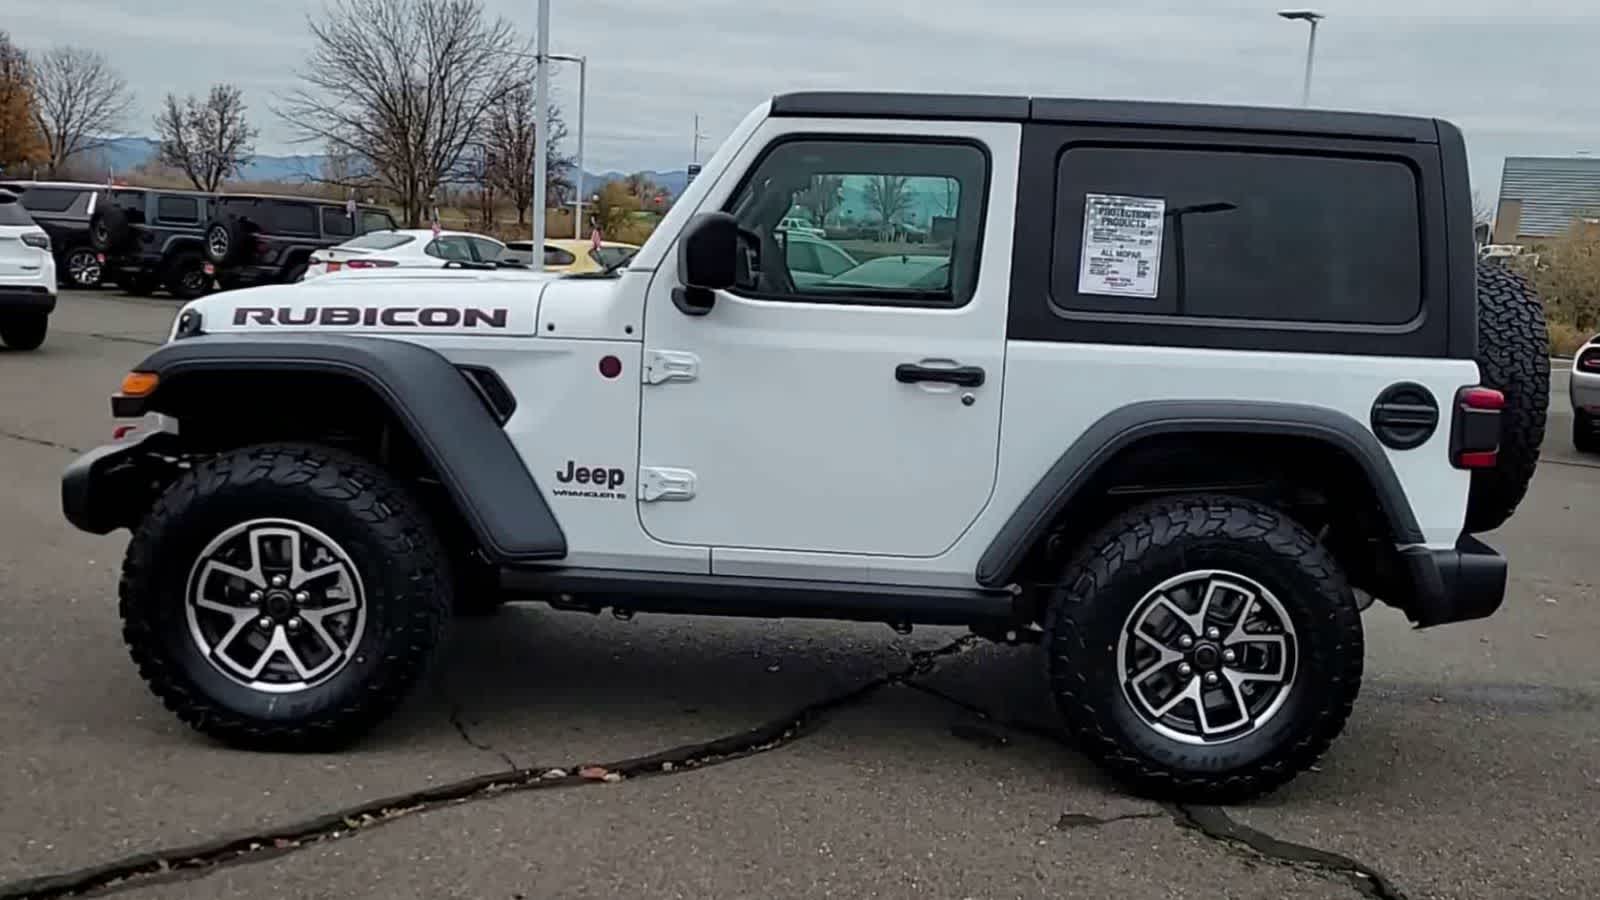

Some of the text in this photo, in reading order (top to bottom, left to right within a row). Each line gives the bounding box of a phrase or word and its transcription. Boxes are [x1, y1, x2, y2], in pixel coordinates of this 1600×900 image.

[1101, 217, 1146, 228] PRODUCTS
[1101, 249, 1142, 259] ALL MOPAR
[232, 307, 508, 328] RUBICON
[556, 460, 625, 490] Jeep
